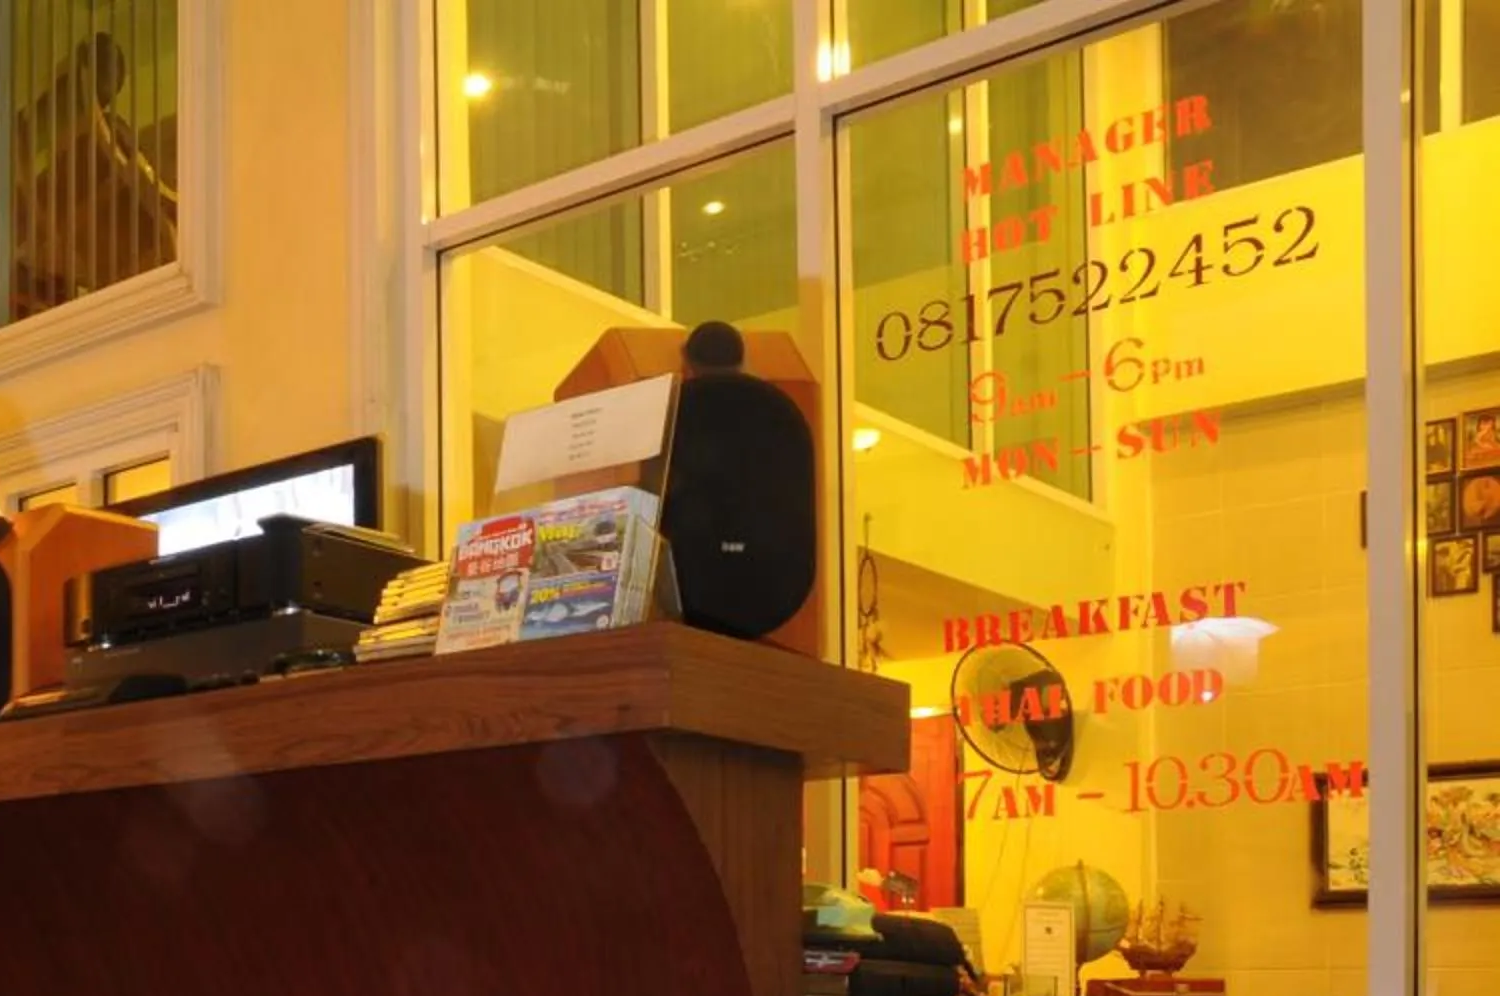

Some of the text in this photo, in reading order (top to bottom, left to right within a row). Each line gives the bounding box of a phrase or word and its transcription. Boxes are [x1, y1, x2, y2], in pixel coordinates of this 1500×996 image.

[961, 95, 1212, 201] MANAGER
[960, 160, 1216, 264] HOT LINE
[876, 206, 1320, 362] 0817522452
[962, 437, 1060, 489] MON
[1116, 408, 1221, 460] SUN
[944, 582, 1246, 652] BREAKFAST
[960, 668, 1224, 726] THAI FOOD
[957, 769, 1056, 820] 7AM
[1123, 749, 1366, 813] 10.30AM
